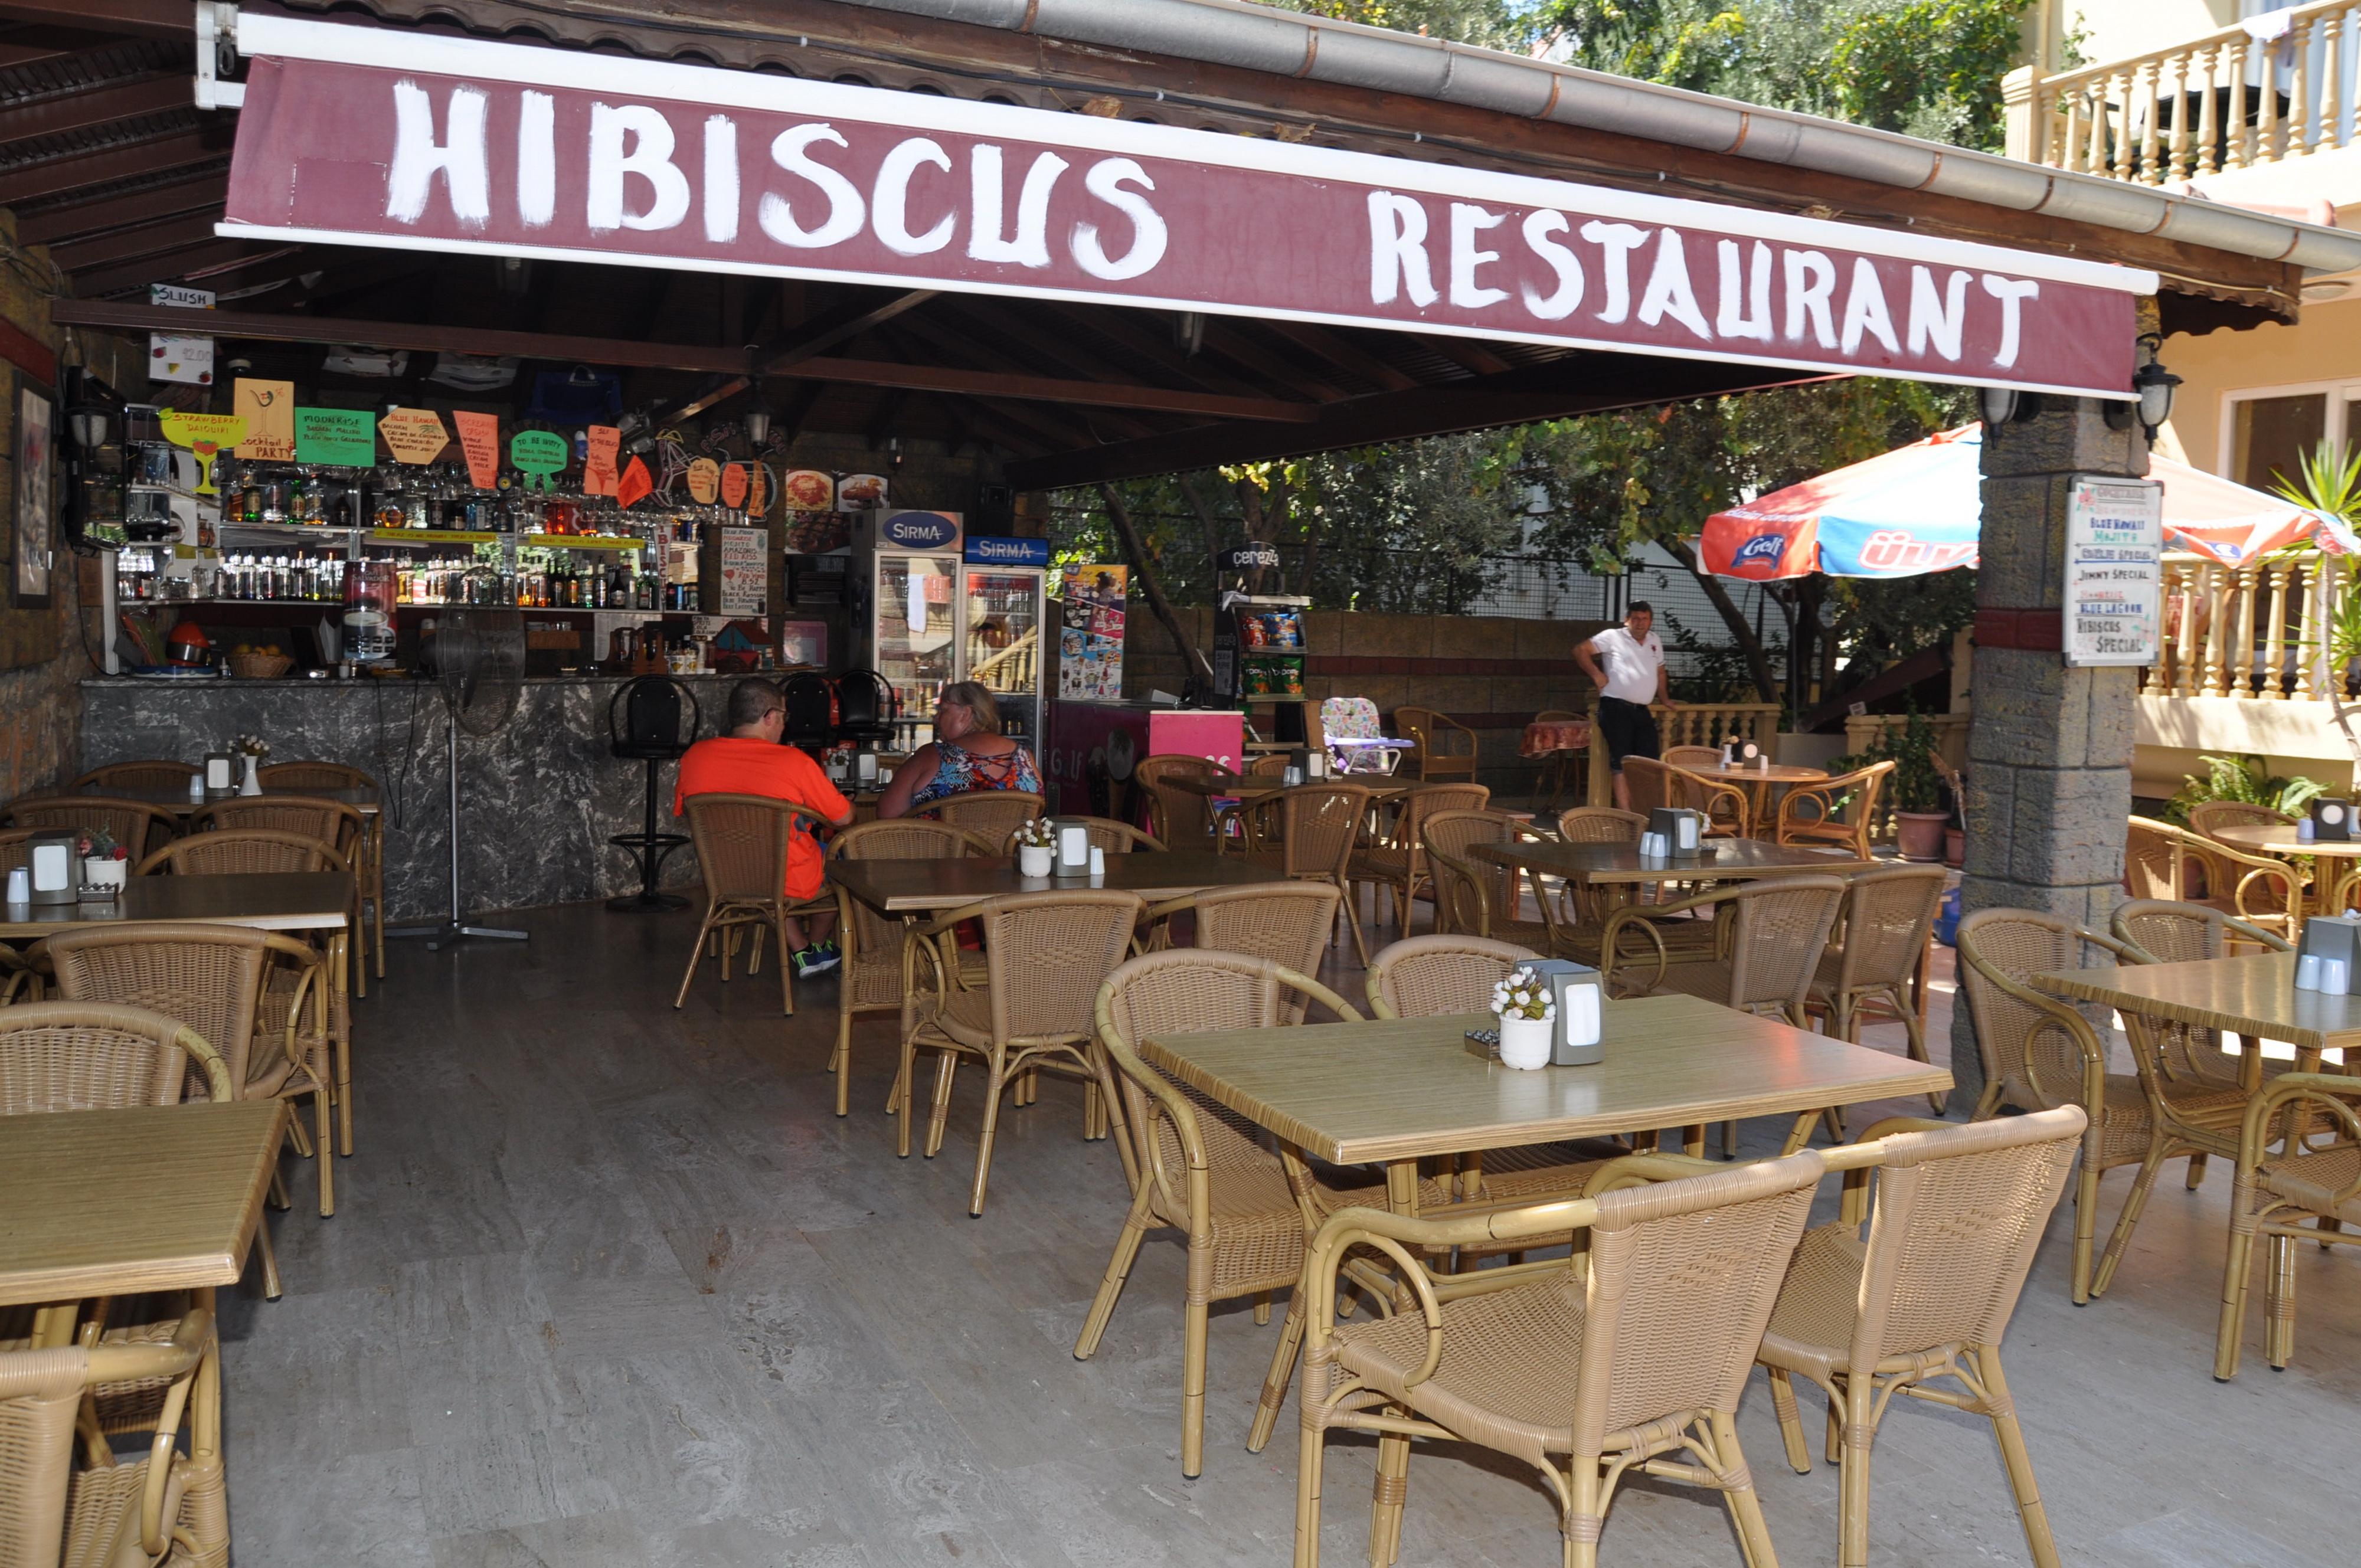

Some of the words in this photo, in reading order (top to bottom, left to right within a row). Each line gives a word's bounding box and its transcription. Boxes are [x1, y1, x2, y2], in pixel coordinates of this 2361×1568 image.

[386, 78, 1168, 280] HIBISCUS
[1366, 189, 2040, 368] RESTAURANT
[158, 287, 207, 305] SLUSH
[172, 414, 240, 424] STRAWBERRY
[304, 415, 361, 425] MOONRISE
[256, 447, 293, 459] PARTY
[2114, 519, 2145, 530] HAWAII
[2113, 568, 2150, 580] SPECIAL
[2080, 604, 2102, 614] BLUE
[2105, 604, 2143, 614] LAGOON
[2076, 618, 2121, 634] HIBISCUS
[2096, 636, 2143, 653] SPECIAL
